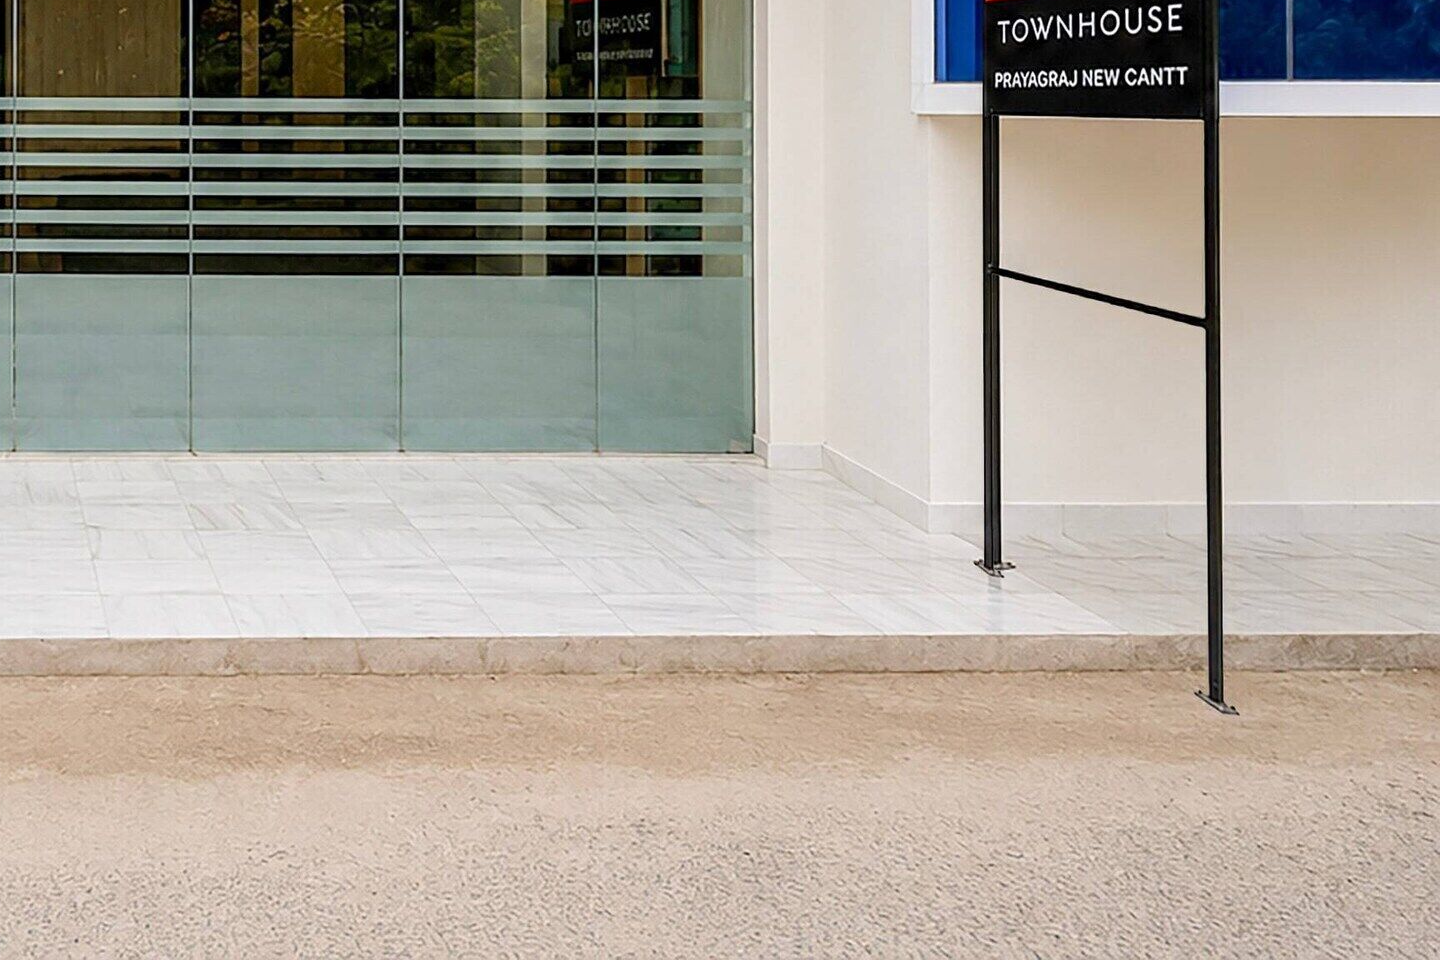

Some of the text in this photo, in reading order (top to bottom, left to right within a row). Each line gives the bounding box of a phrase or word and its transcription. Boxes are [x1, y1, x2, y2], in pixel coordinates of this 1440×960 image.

[997, 3, 1183, 44] TOWNHOUSE
[994, 66, 1188, 88] PRAYAGRAJ NEW CANTT
